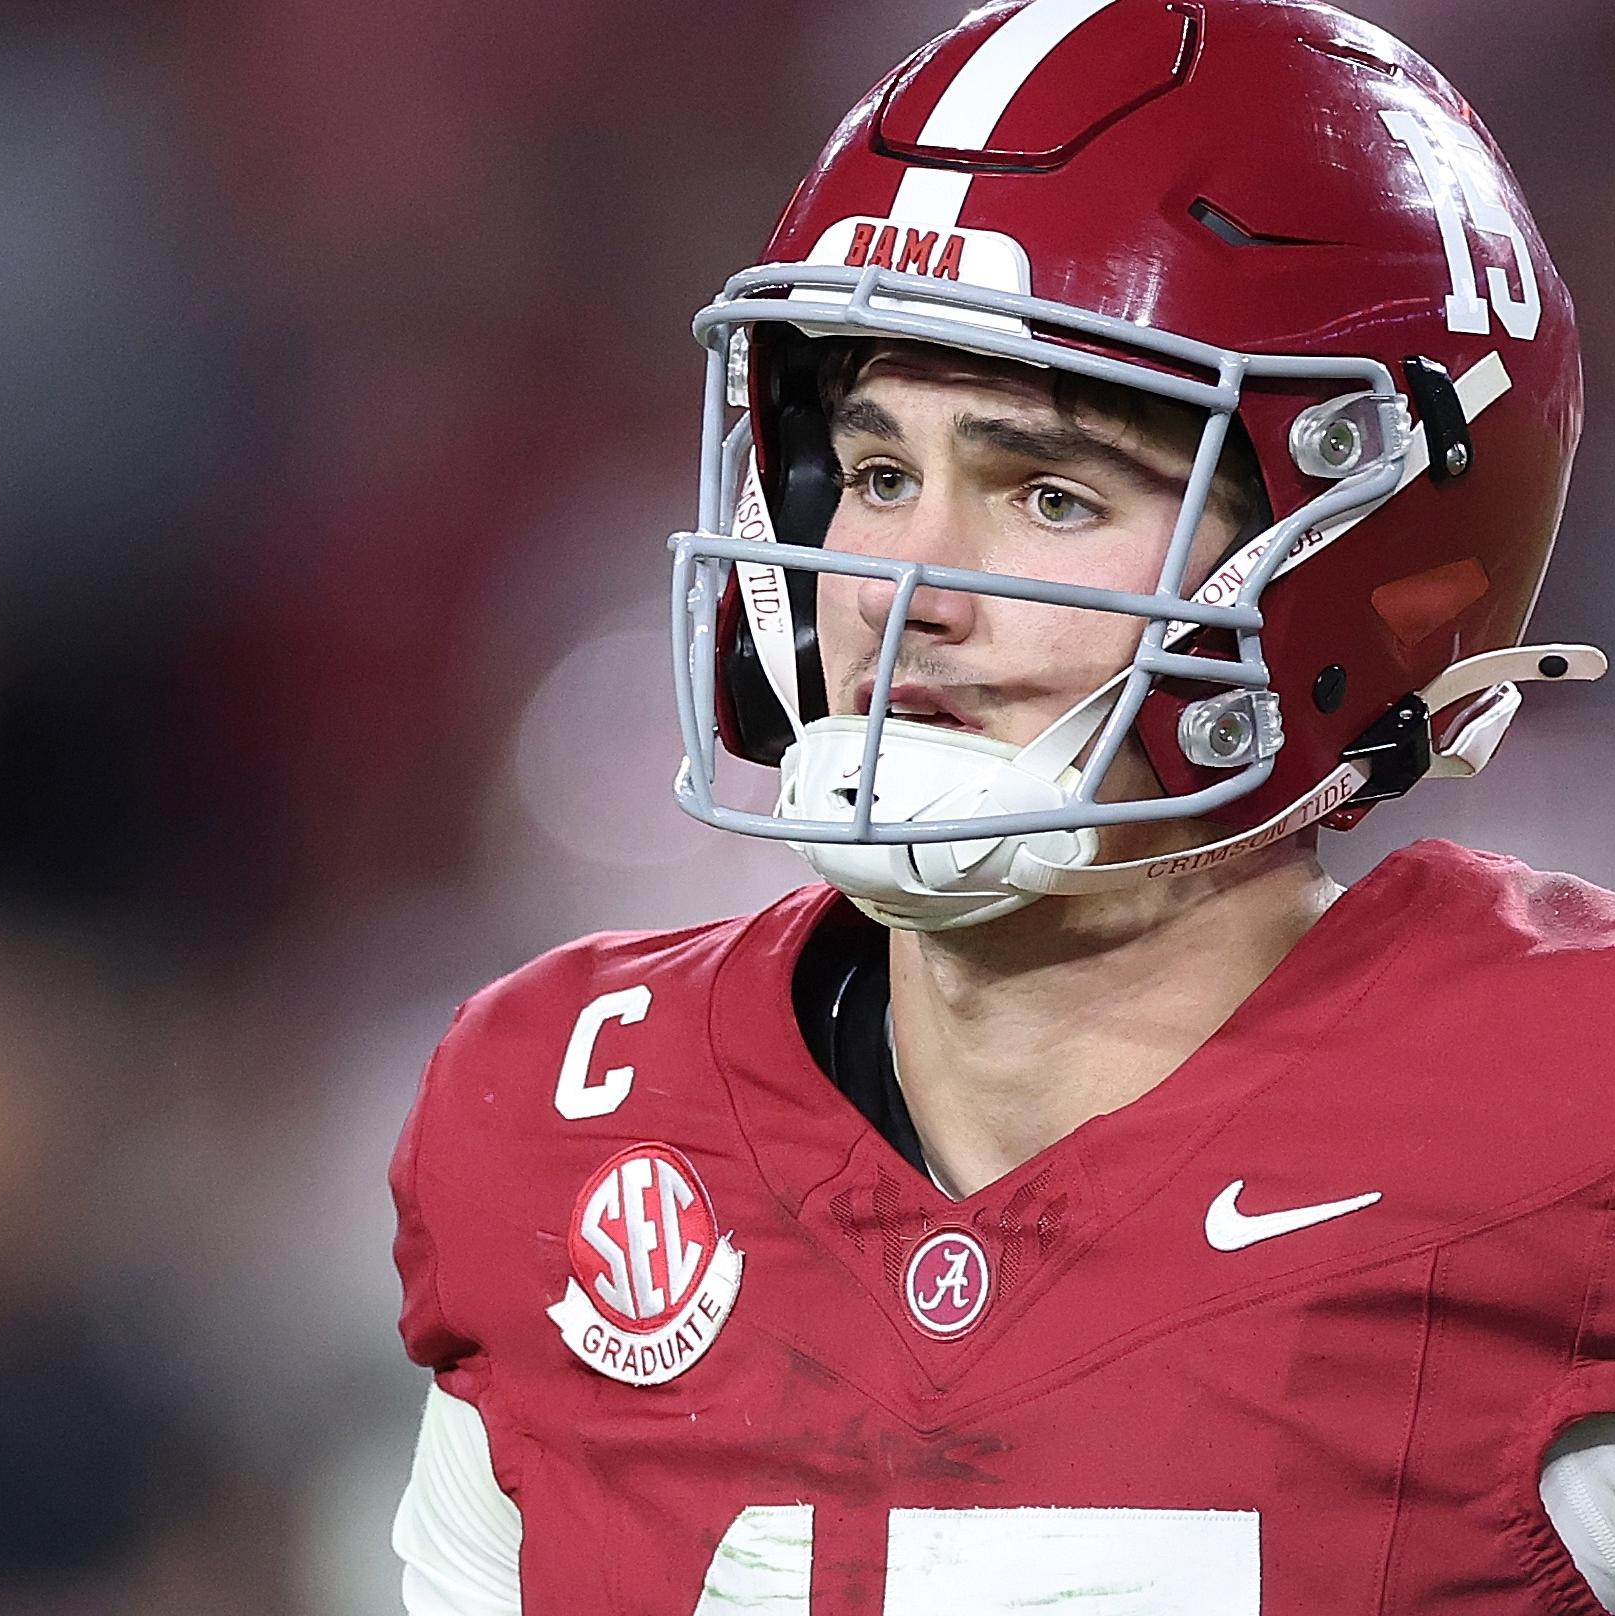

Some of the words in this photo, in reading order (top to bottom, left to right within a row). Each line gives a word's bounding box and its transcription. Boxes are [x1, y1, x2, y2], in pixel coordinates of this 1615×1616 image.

[844, 223, 966, 281] BAMA
[1377, 109, 1542, 341] 15
[1301, 772, 1354, 824] TIDE
[553, 984, 654, 1121] C
[580, 1157, 704, 1321] SEC
[582, 1291, 722, 1378] GRADUATE
